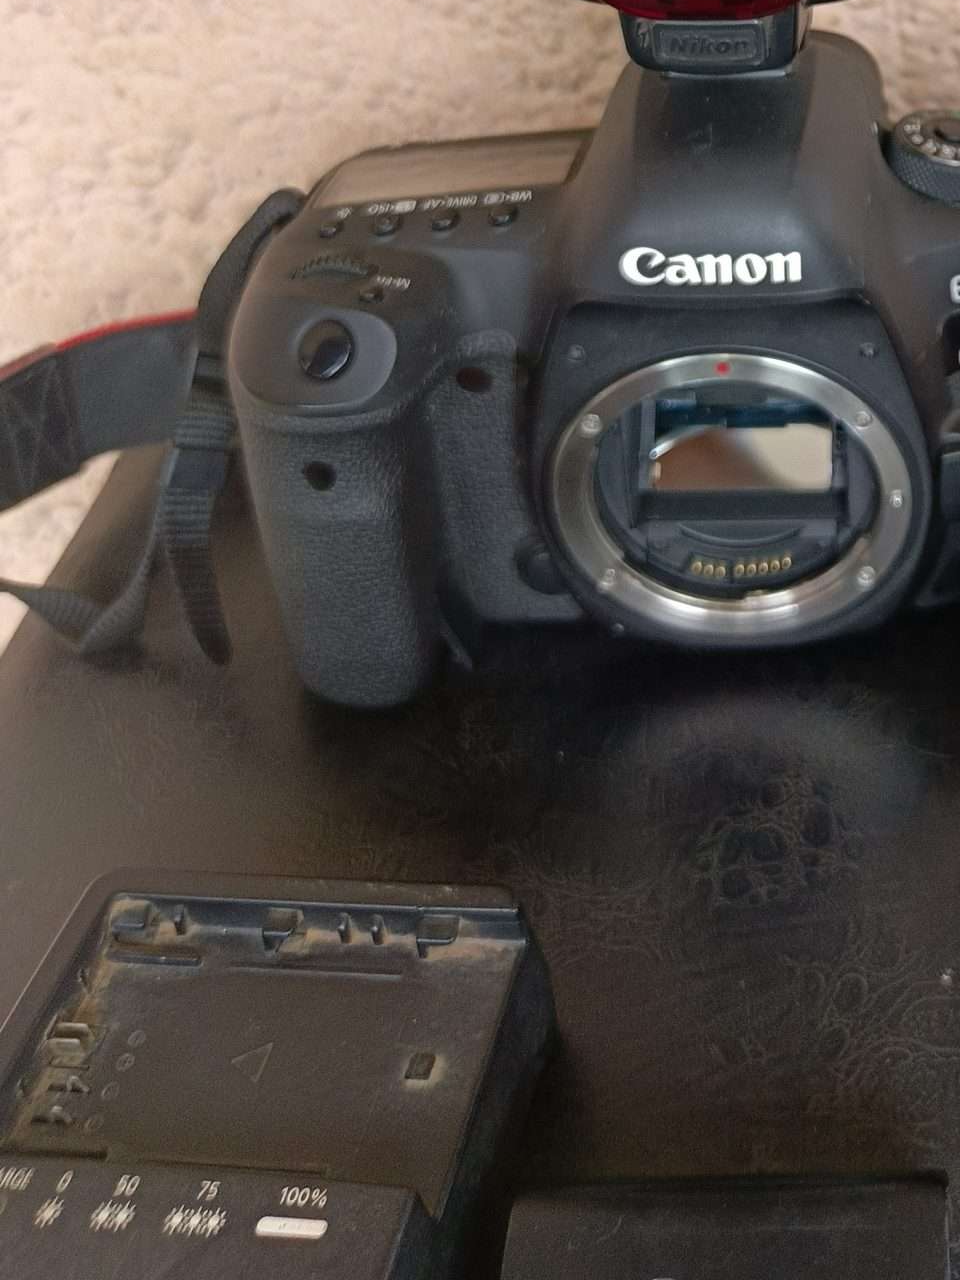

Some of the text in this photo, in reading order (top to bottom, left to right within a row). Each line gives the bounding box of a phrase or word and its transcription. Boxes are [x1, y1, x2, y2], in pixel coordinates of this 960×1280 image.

[668, 36, 748, 55] Nikon
[619, 246, 802, 286] Canon
[196, 1180, 222, 1201] 75
[279, 1186, 328, 1209] 100%
